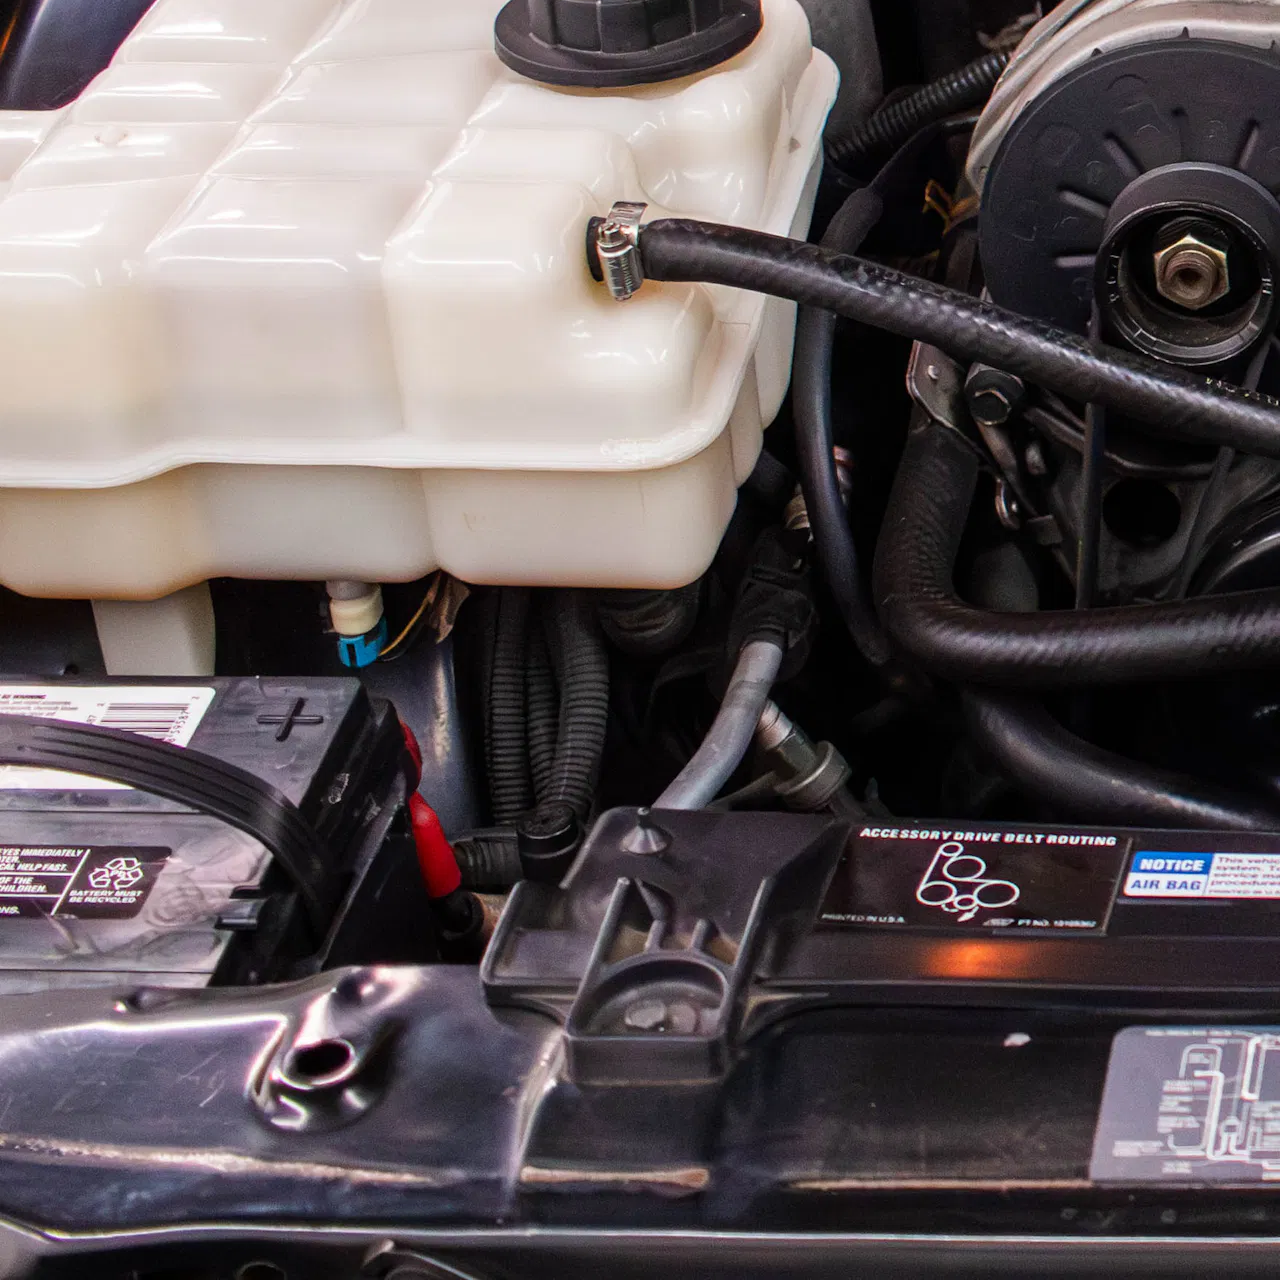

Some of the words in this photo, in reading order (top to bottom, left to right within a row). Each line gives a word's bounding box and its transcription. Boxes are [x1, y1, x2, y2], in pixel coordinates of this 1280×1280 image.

[859, 827, 952, 840] ACCESSORY
[953, 830, 1001, 842] DRIVE
[1003, 833, 1042, 844] BELT
[1046, 834, 1117, 846] ROUTING
[20, 848, 83, 857] IMMEDIATELY
[1140, 858, 1205, 872] NOTICE
[1218, 856, 1243, 864] This
[17, 863, 43, 871] HELP
[41, 863, 69, 872] FAST.
[1131, 879, 1160, 890] AIR
[1166, 880, 1202, 891] BAG
